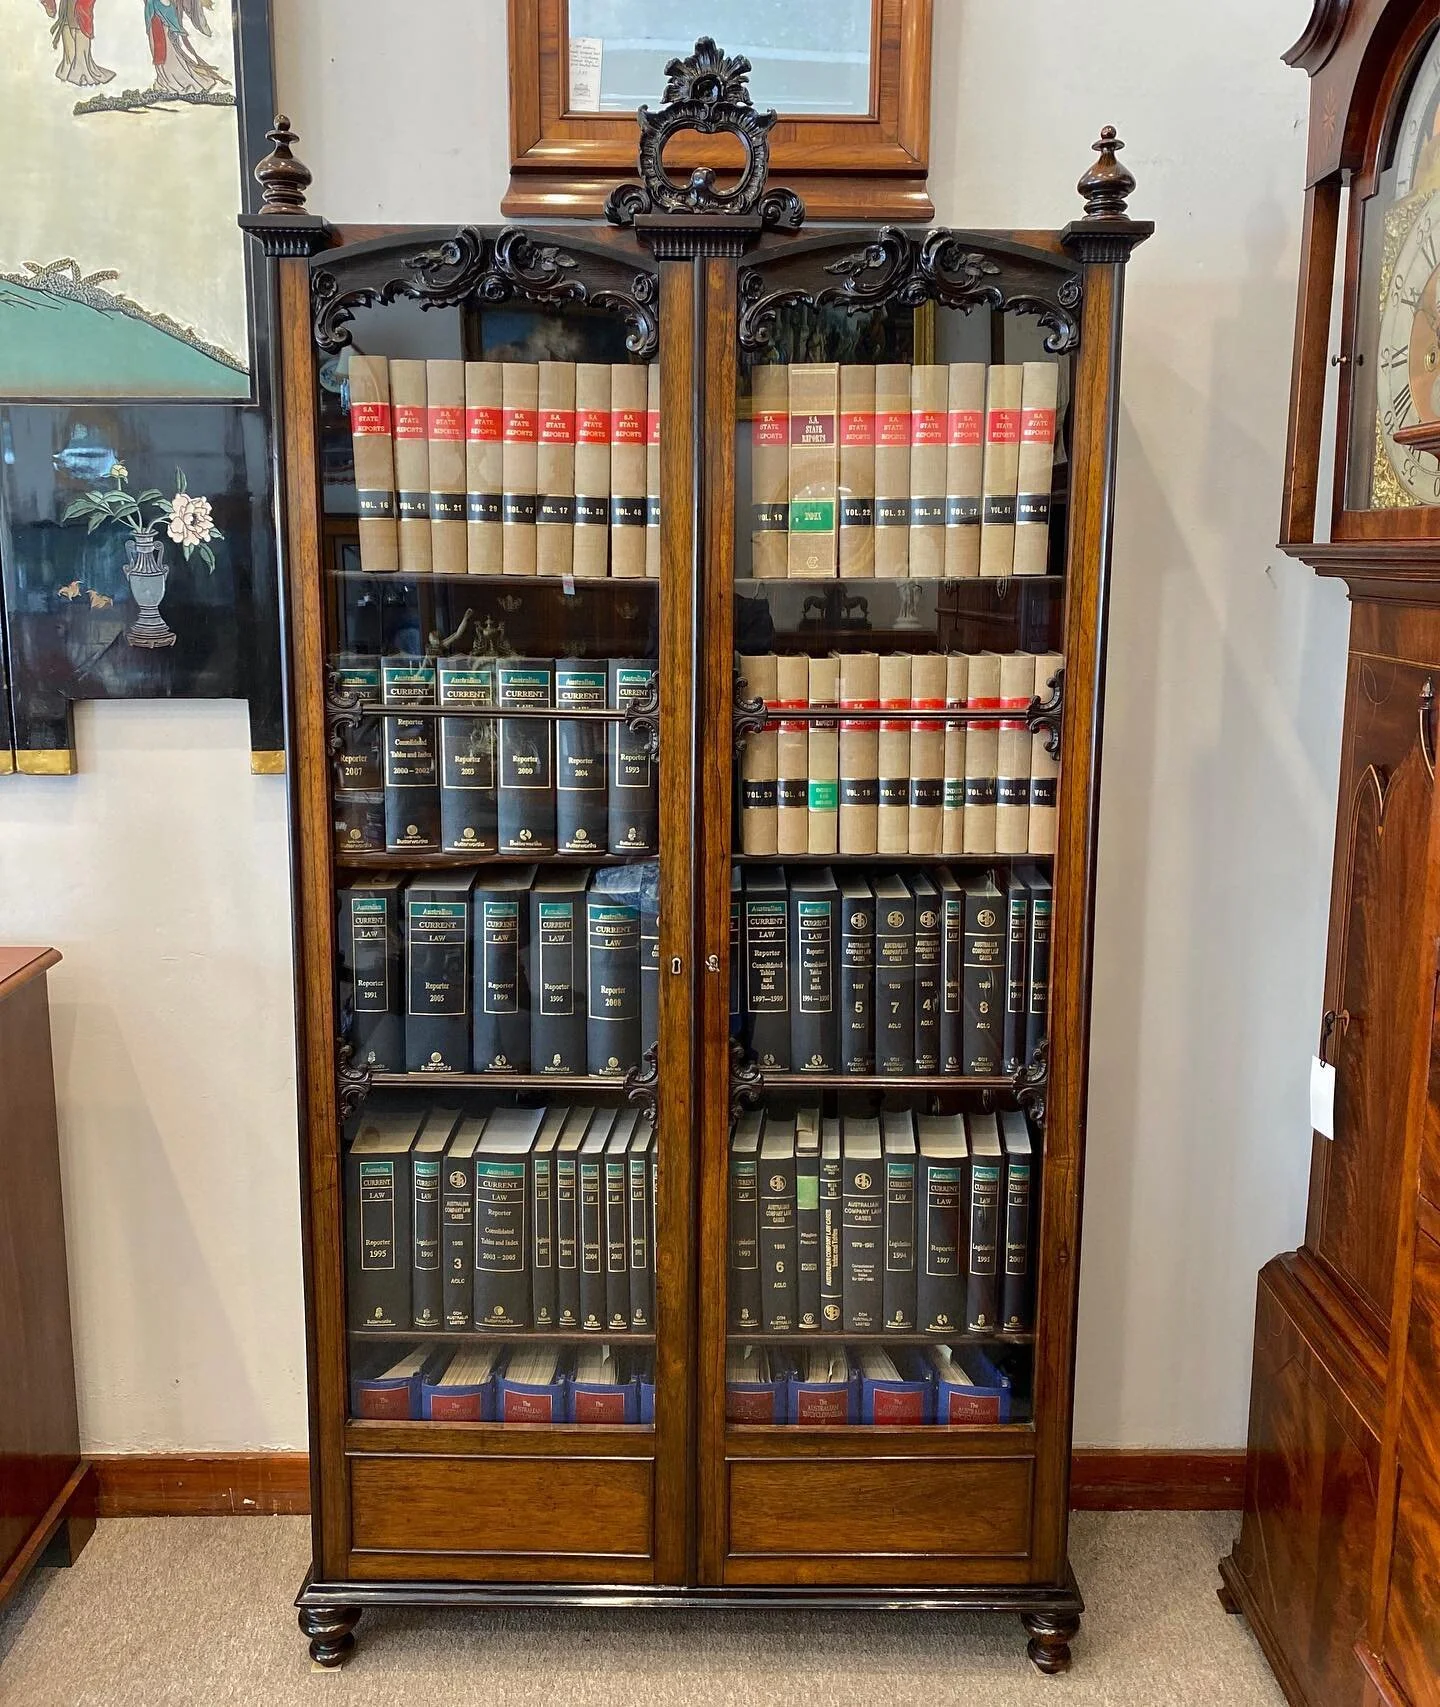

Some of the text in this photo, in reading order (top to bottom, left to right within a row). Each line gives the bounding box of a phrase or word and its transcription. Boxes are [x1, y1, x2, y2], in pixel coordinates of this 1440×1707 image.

[506, 429, 533, 437] REPORTS
[579, 429, 606, 438] REPORTS
[805, 425, 823, 434] STATE
[542, 430, 570, 438] REPORTS
[615, 430, 642, 438] REPORTS
[802, 434, 826, 442] REPORTS
[916, 431, 941, 439] REPORTS
[390, 688, 429, 696] CURRENT
[447, 690, 485, 698] CURRENT
[505, 690, 544, 698] CURRENT
[562, 692, 600, 700] CURRENT
[398, 718, 424, 726] Reporter
[455, 755, 481, 764] Reporter
[512, 754, 538, 764] Reporter
[568, 756, 593, 765] Reporter
[620, 754, 646, 763] Reporter
[345, 767, 363, 776] 2007
[418, 921, 456, 929] CURRENT
[486, 920, 517, 928] CURRENT
[542, 921, 571, 929] CURRENT
[429, 934, 446, 942] LAW
[548, 934, 565, 942] LAW
[358, 979, 384, 988] Reporter
[425, 982, 450, 990] Reporter
[600, 986, 626, 996] Reporter
[854, 1001, 863, 1013] 5
[890, 1002, 900, 1014] 7
[922, 998, 932, 1010] 4
[979, 1001, 989, 1013] 8
[483, 1180, 518, 1189] CURRENT
[488, 1208, 512, 1217] Reporter
[365, 1239, 391, 1247] Reporter
[453, 1258, 462, 1269] 3
[775, 1261, 785, 1273] 6
